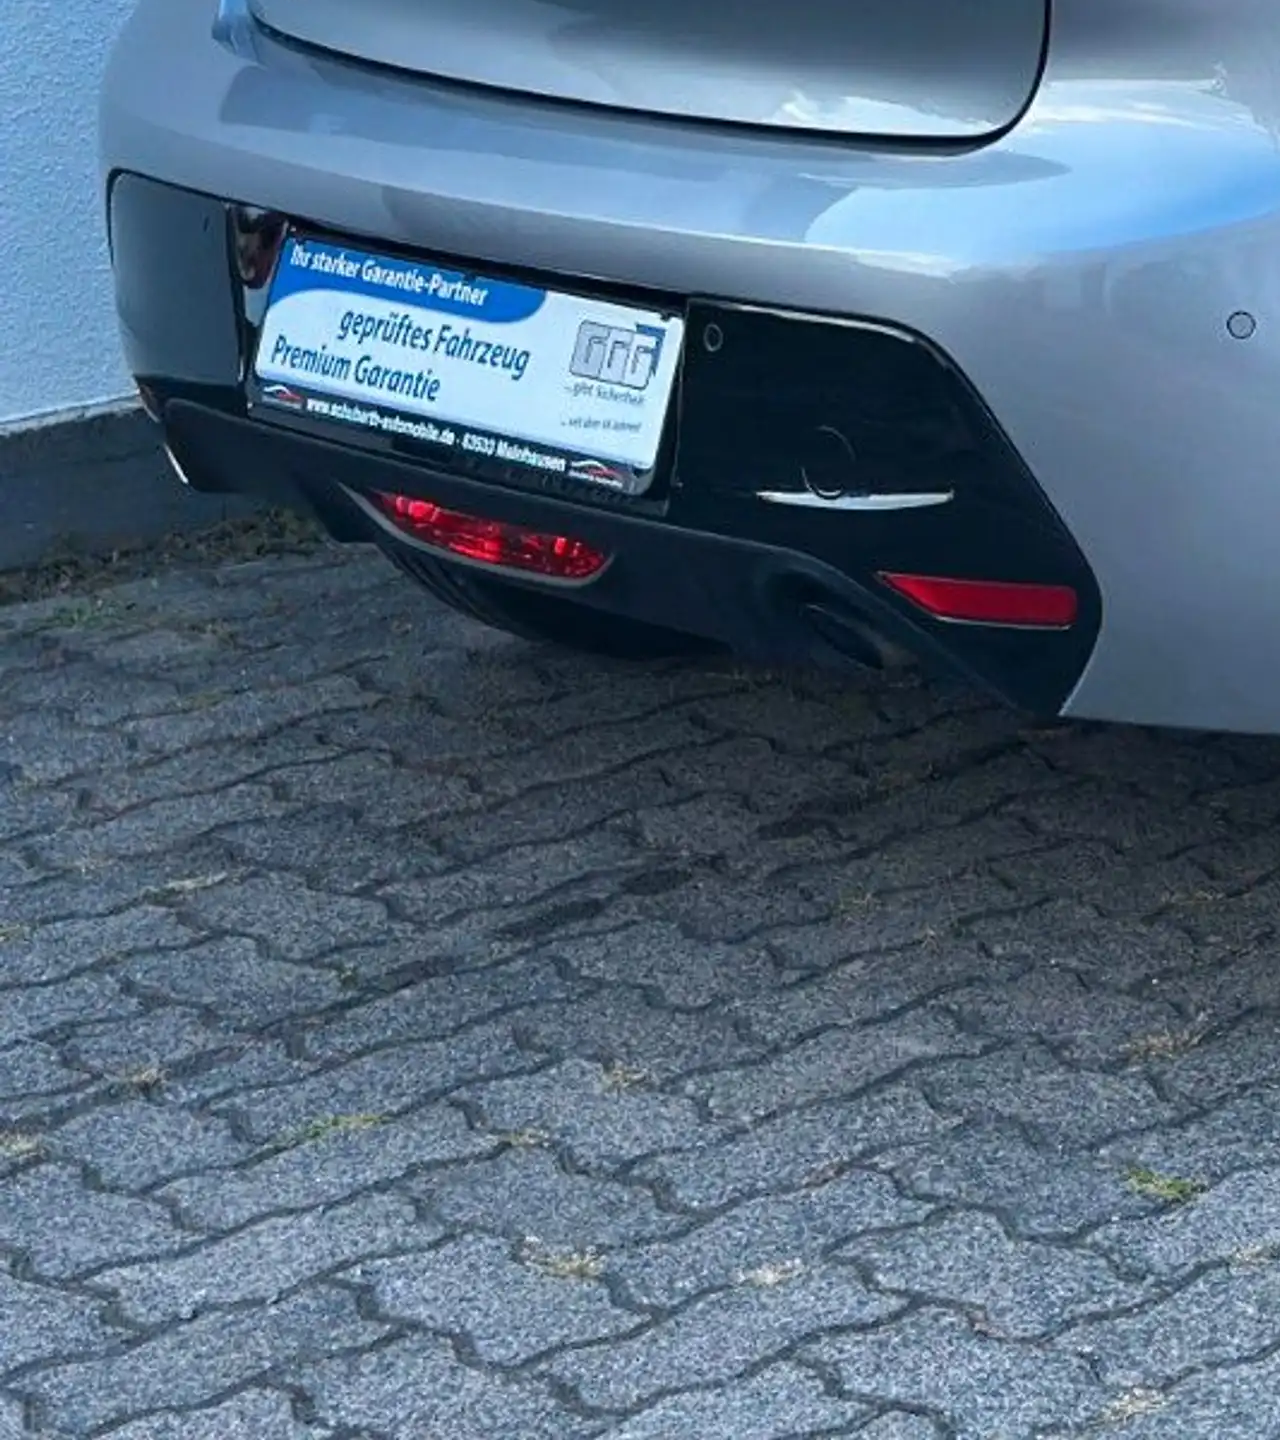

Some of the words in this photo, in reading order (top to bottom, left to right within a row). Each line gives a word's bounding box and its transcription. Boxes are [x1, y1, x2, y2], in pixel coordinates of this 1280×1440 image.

[289, 244, 311, 268] Ihr
[310, 253, 360, 280] starker
[361, 260, 489, 308] Garantie-Partner
[271, 334, 351, 381] Premium
[353, 355, 441, 403] Garantie
[337, 308, 431, 353] geprüftes
[433, 324, 530, 381] Fahrzeug
